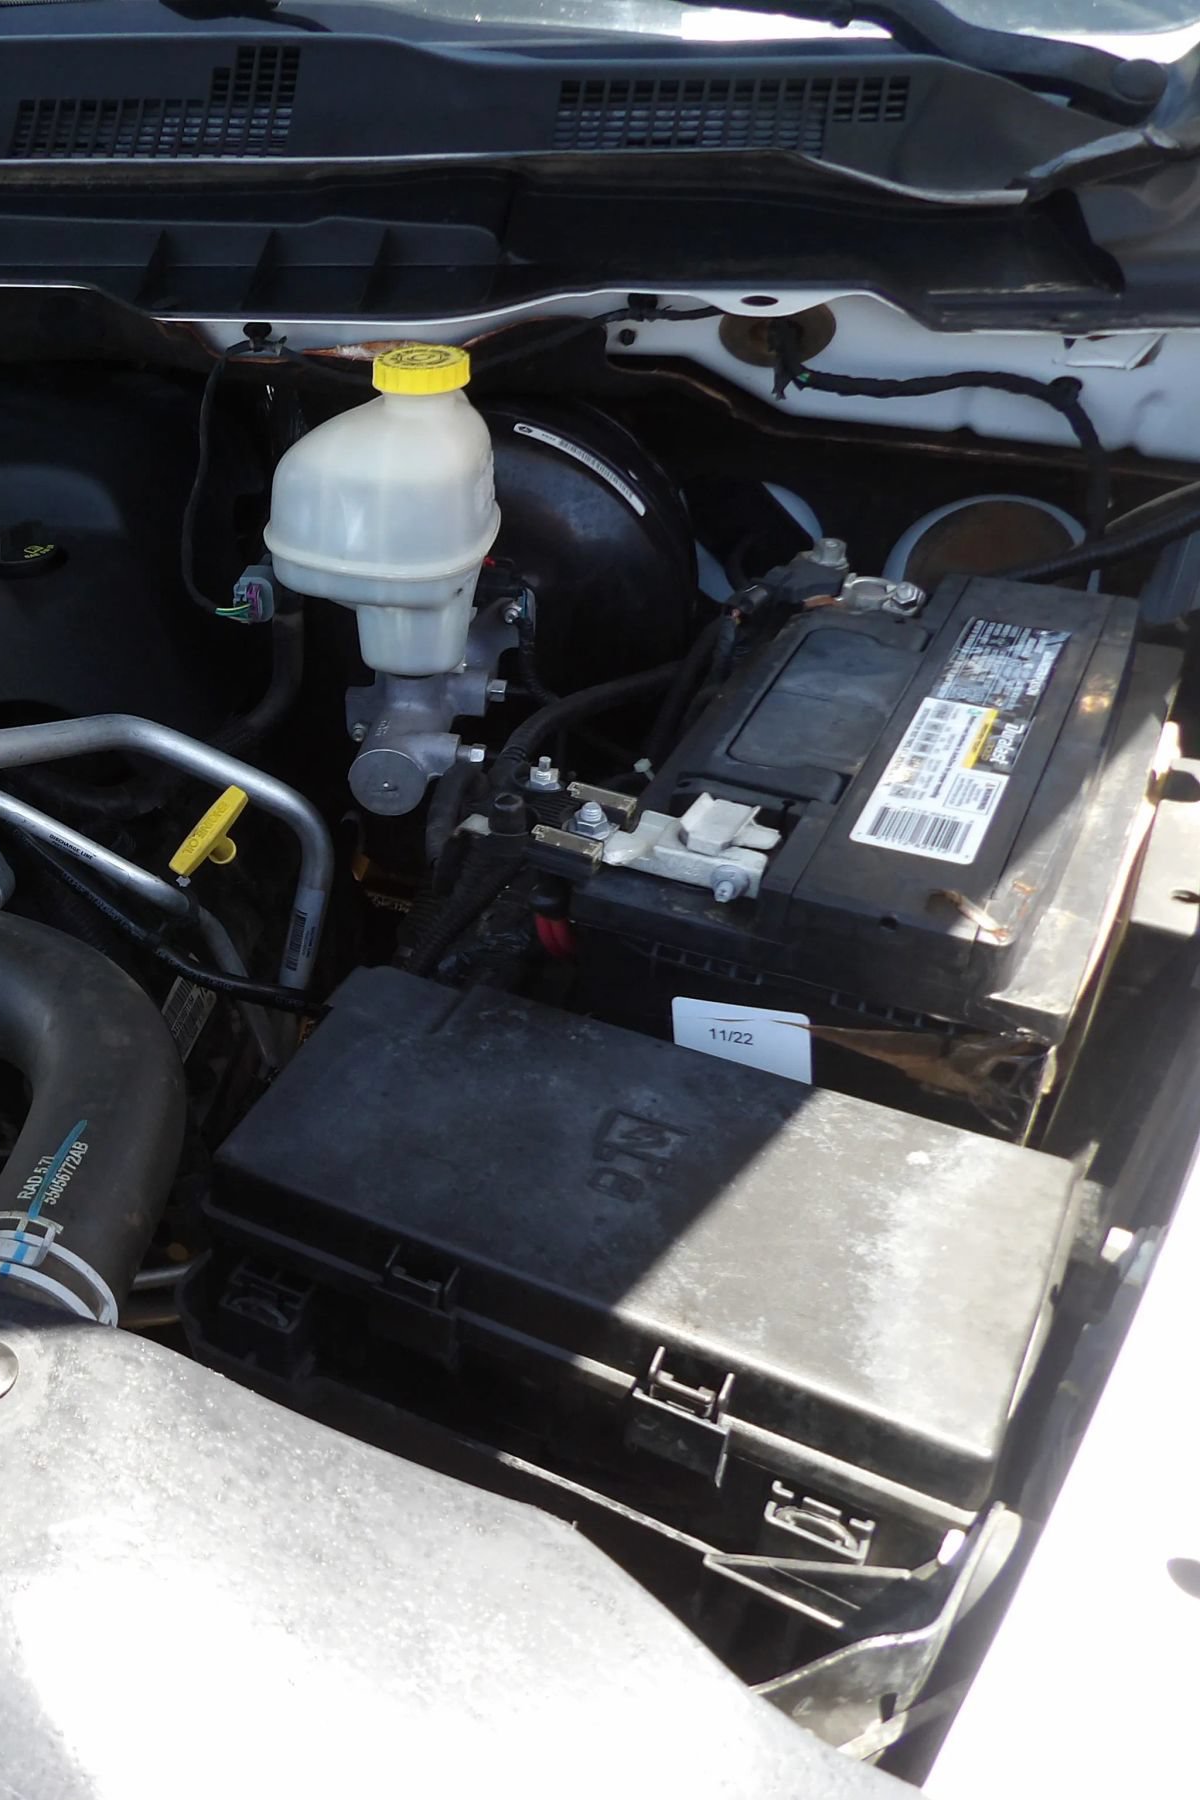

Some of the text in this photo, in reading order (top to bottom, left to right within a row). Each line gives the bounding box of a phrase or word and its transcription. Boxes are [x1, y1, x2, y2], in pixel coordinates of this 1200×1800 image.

[989, 723, 1025, 765] Duralast
[182, 838, 199, 854] OIL
[708, 1027, 754, 1046] 11/22
[44, 1141, 89, 1205] 55056772AB
[17, 1175, 43, 1200] RAD
